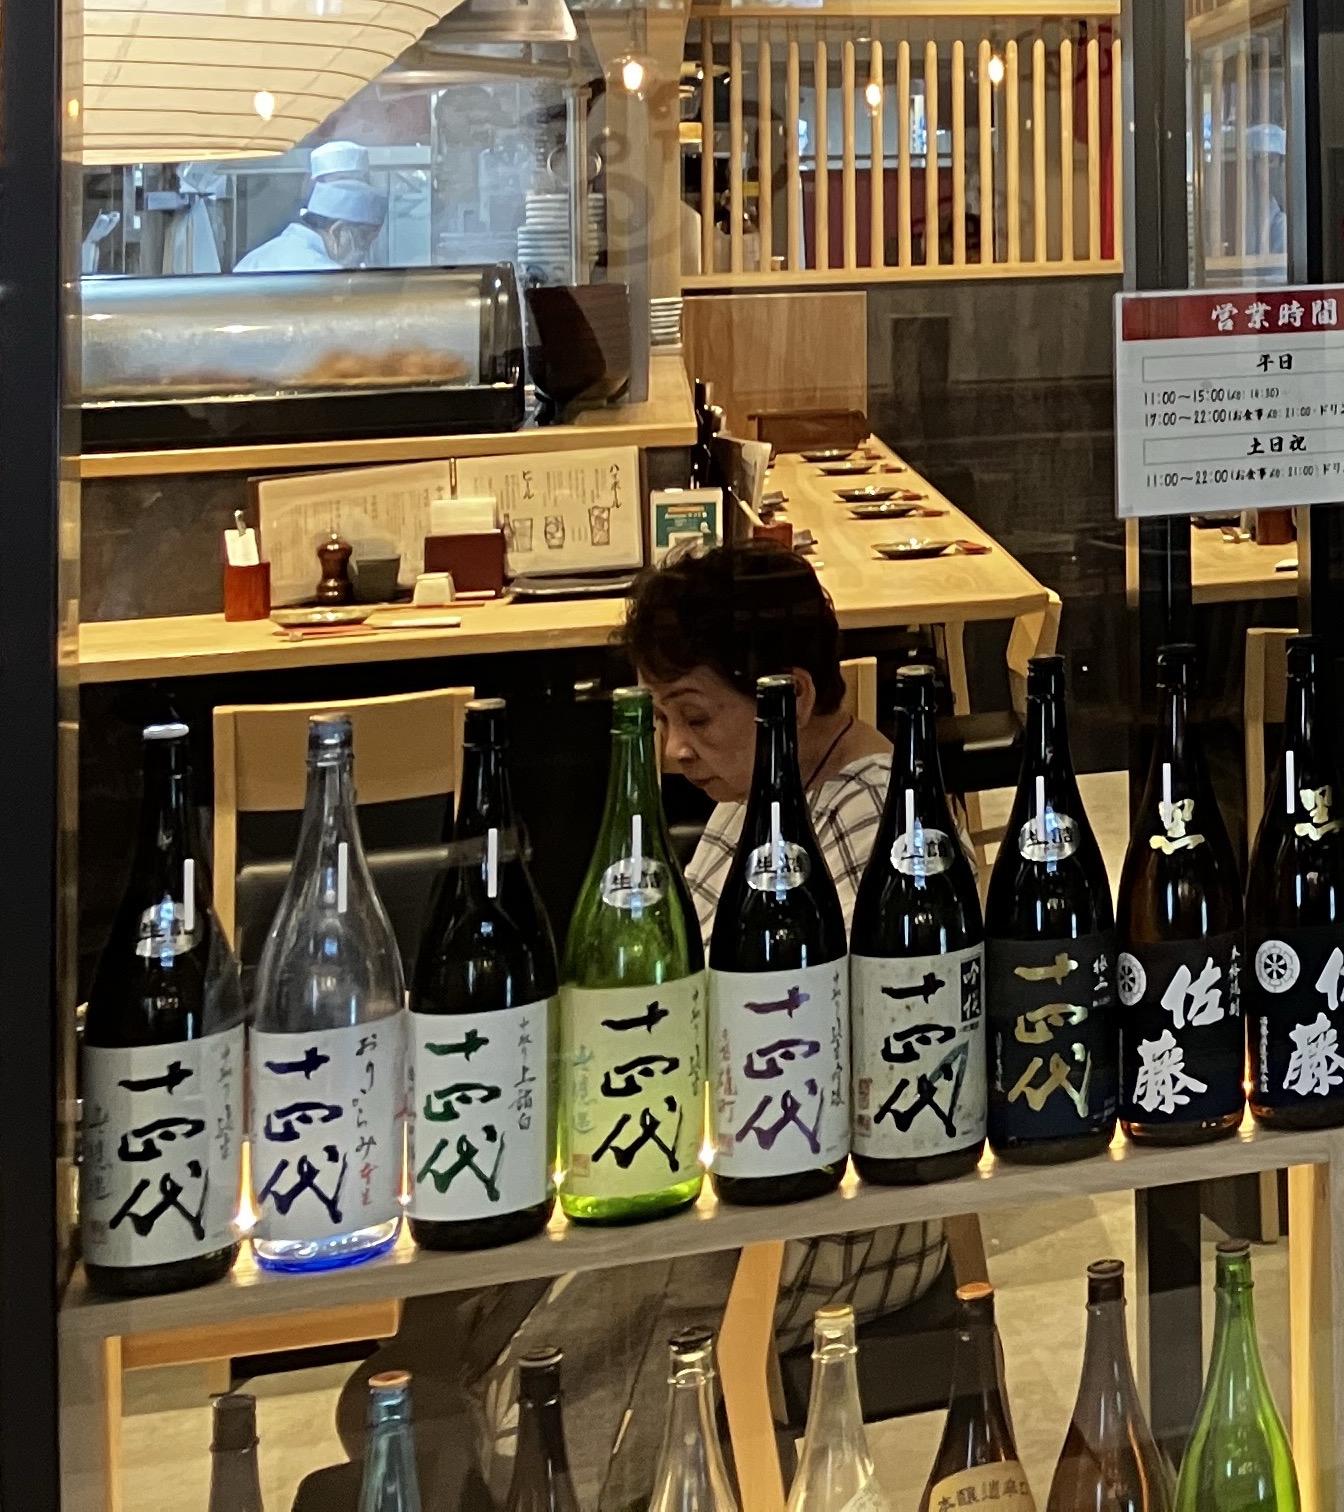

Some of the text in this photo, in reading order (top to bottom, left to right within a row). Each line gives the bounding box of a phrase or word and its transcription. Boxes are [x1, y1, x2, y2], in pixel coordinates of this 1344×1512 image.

[1210, 297, 1339, 332] 営業時間
[1256, 353, 1294, 373] 平日
[1246, 434, 1308, 456] 土日祝
[416, 1028, 504, 1203] 十四代
[591, 1000, 684, 1173] 十四代
[735, 985, 821, 1155] 十四代
[873, 972, 957, 1139] 十四代
[1007, 952, 1094, 1119] 十四代
[1132, 956, 1227, 1115] 佐藤
[109, 1060, 207, 1242] 十四代
[258, 1046, 344, 1225] 十四代
